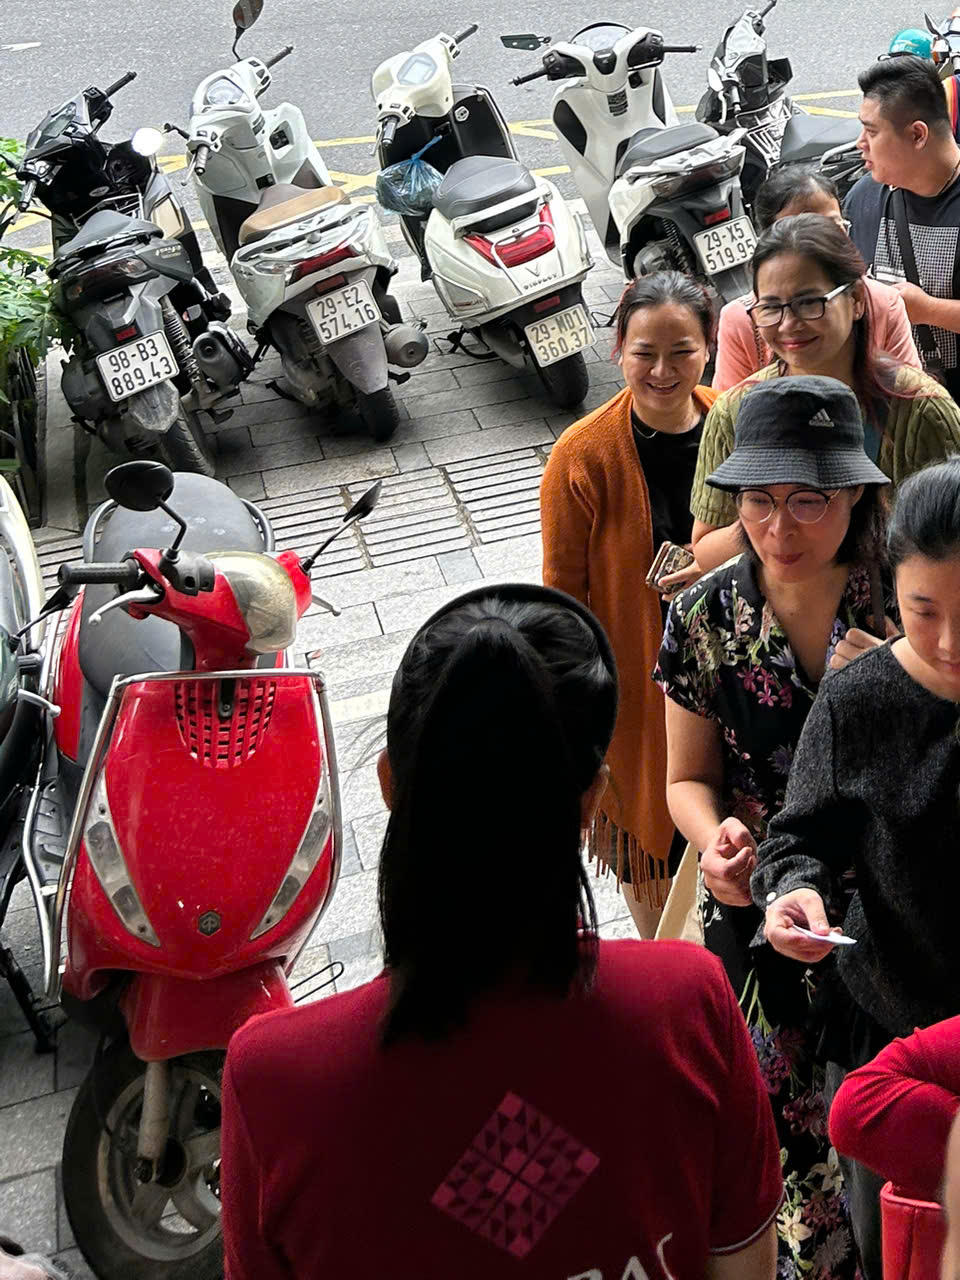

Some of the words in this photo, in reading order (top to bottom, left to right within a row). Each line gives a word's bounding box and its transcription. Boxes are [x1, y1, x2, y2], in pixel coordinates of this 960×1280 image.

[703, 222, 745, 252] 29-X5
[705, 238, 756, 271] 519.95
[316, 286, 364, 320] 29-E2
[319, 303, 376, 340] 574.16
[108, 338, 159, 373] 98-B3
[538, 326, 589, 362] 360.37
[111, 356, 173, 396] 889.43
